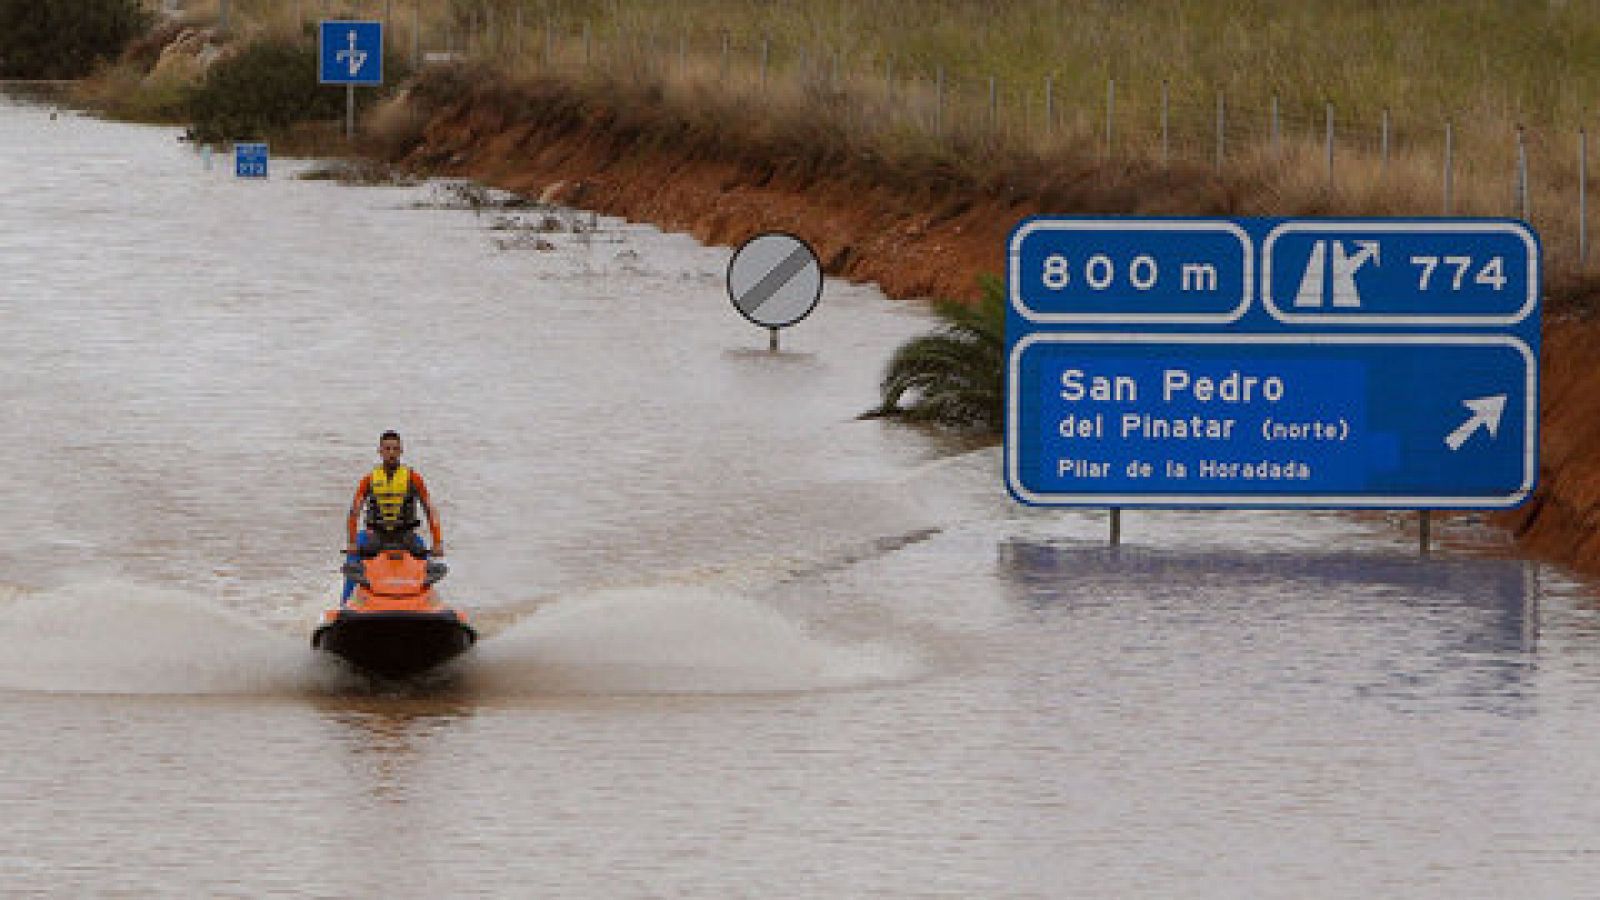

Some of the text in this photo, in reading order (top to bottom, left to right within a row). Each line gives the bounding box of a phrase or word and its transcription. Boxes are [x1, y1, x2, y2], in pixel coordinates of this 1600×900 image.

[1042, 255, 1217, 291] 800 m
[1409, 256, 1507, 291] 774
[1060, 369, 1284, 401] San Pedro
[1059, 414, 1349, 442] del Pinatar (norte)
[1059, 459, 1311, 479] Pilar de la Horadada
